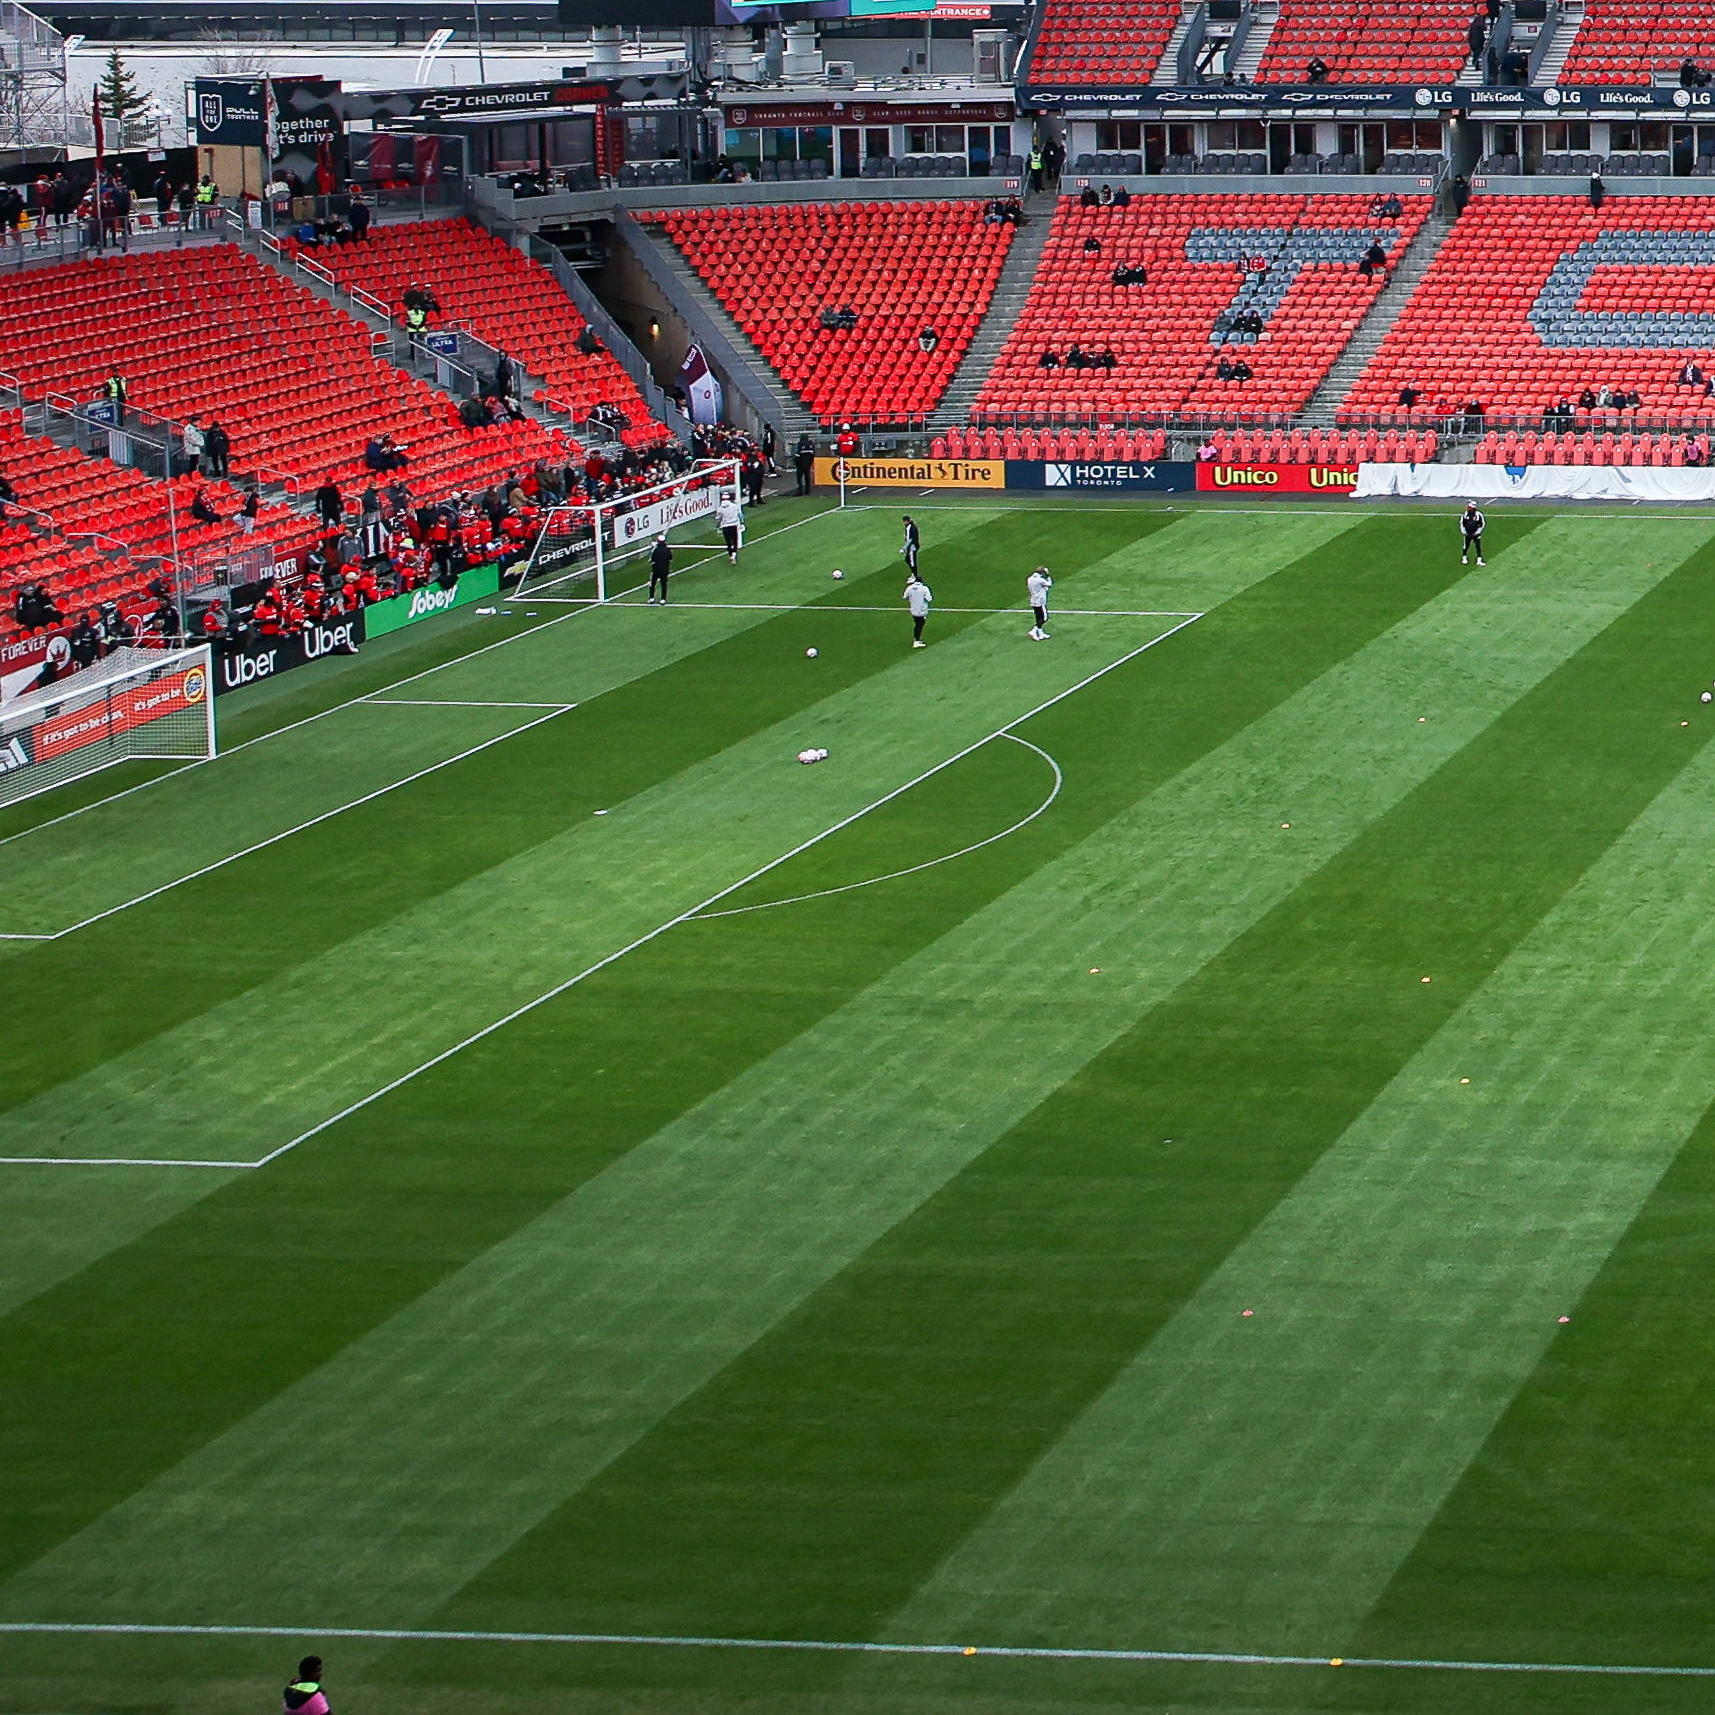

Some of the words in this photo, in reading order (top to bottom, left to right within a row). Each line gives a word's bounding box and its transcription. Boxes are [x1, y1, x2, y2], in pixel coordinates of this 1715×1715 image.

[465, 91, 551, 106] CHEVROLET
[1064, 94, 1142, 102] CHEVROLET
[1190, 94, 1268, 102] CHEVROLET
[1316, 94, 1392, 102] CHEVROLET
[1434, 91, 1453, 103] LG
[1471, 91, 1494, 103] Life's
[1494, 92, 1525, 103] Good.
[1562, 91, 1581, 103] LG
[1600, 91, 1624, 103] Life's
[1624, 92, 1654, 103] Good.
[1692, 92, 1711, 104] LG
[273, 117, 330, 132] ogether
[830, 459, 934, 483] Continental
[948, 462, 991, 482] Tire
[1075, 466, 1127, 479] HOTEL
[1132, 467, 1156, 479] X
[1214, 467, 1279, 487] Unico
[1310, 467, 1359, 487] Unic
[684, 490, 713, 520] Good.
[637, 517, 650, 532] LG
[538, 531, 611, 566] CHEVROLT
[408, 584, 459, 620] Sobeys
[304, 622, 354, 660] Uber
[1, 636, 48, 663] FOREVER
[224, 649, 278, 687] Uber
